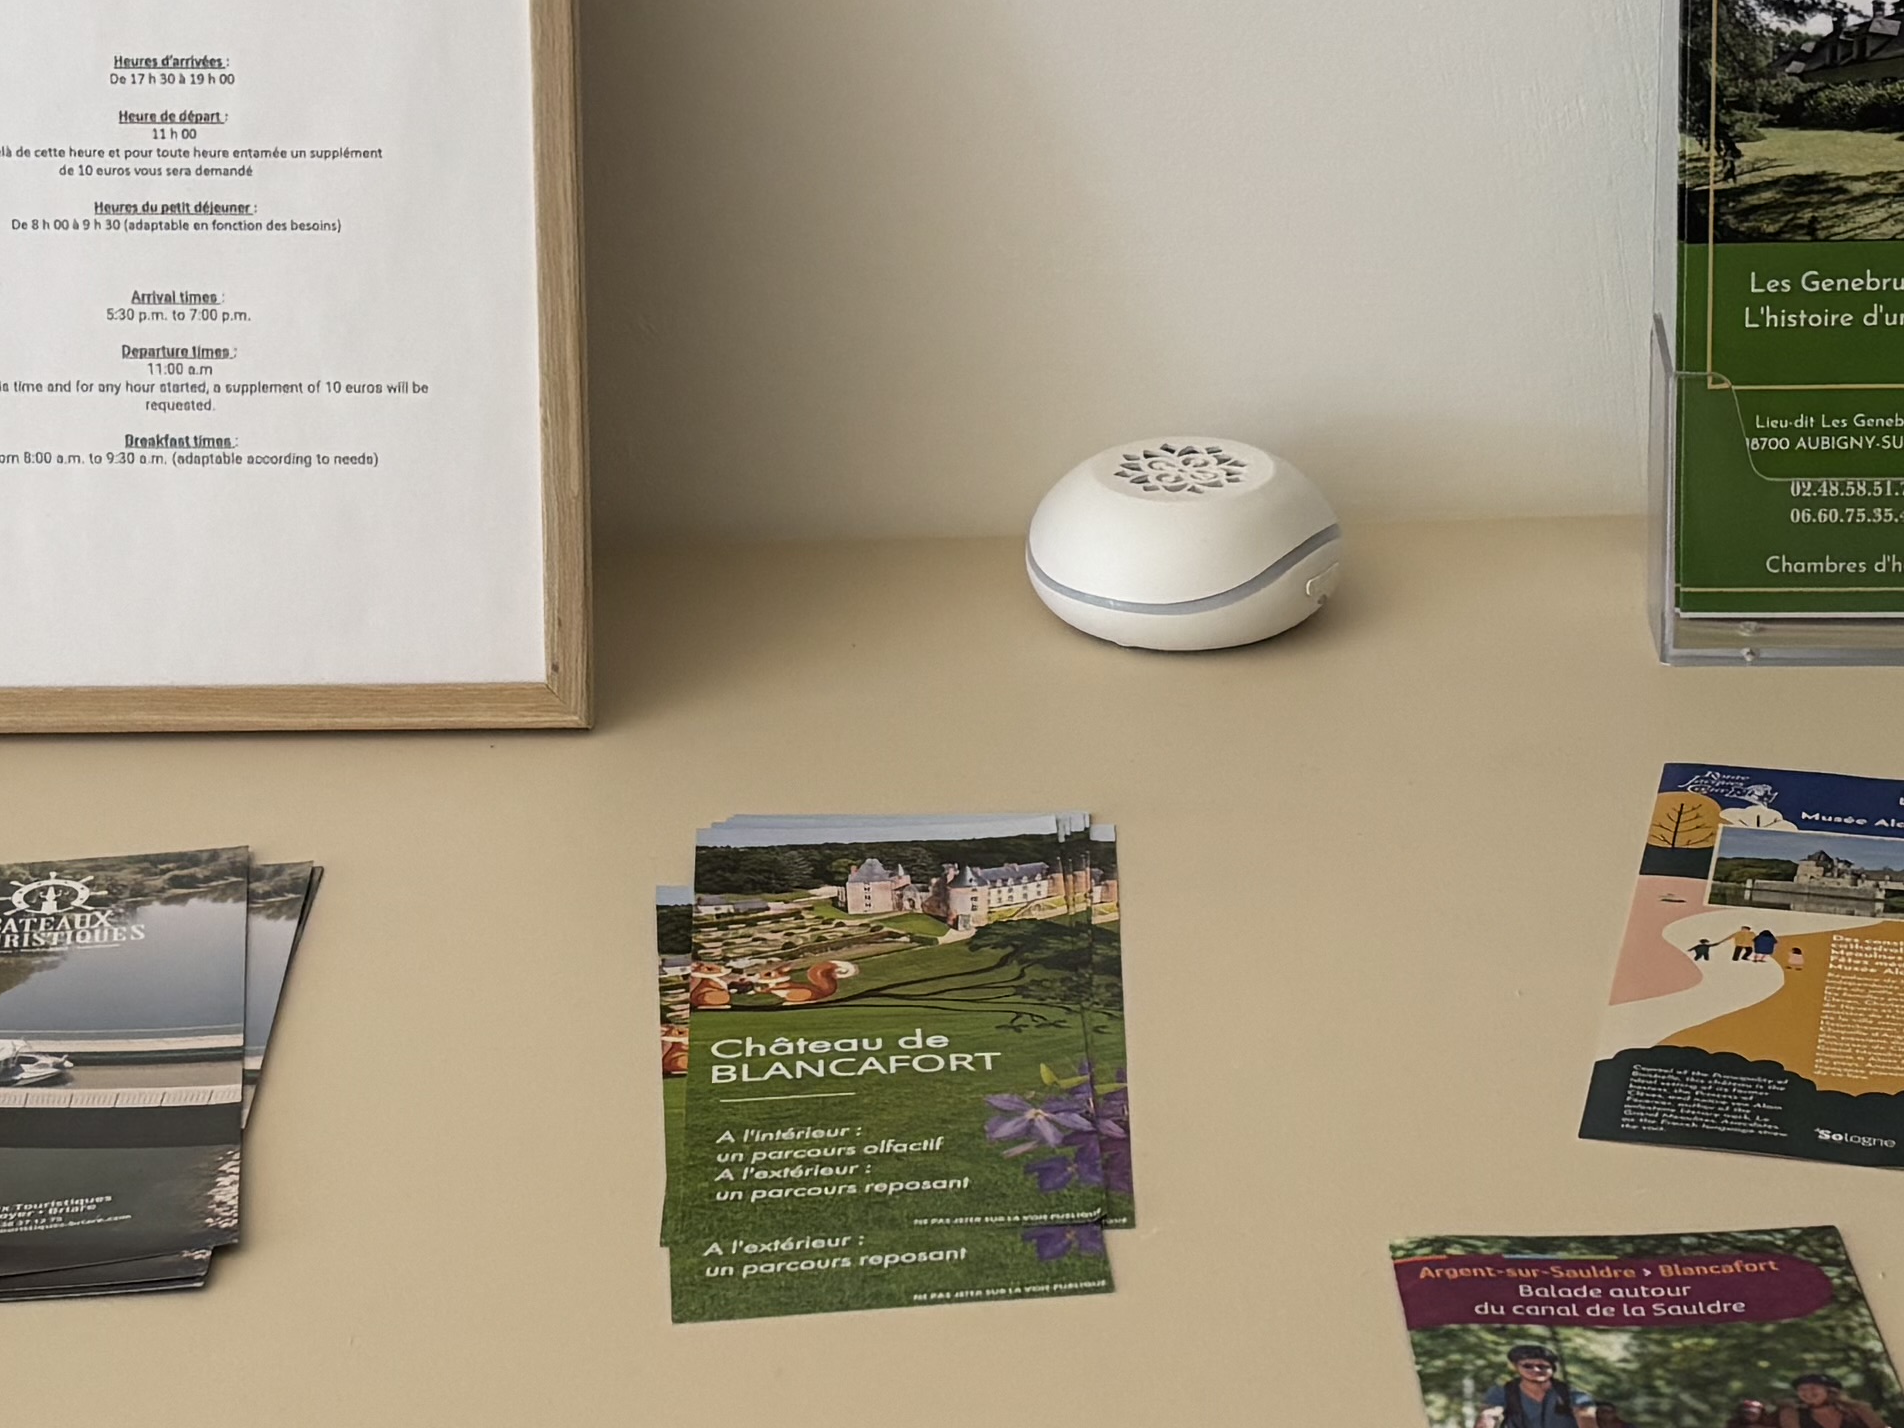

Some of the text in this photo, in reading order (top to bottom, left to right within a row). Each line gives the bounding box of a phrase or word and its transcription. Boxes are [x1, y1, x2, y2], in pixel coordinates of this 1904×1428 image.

[58, 164, 252, 176] de 10 euros vous sera demandé
[1750, 271, 1790, 292] Les
[1744, 304, 1853, 327] L'histoire
[1755, 413, 1814, 428] Lieu-dit
[1821, 413, 1847, 427] Les
[1765, 554, 1866, 573] Chambres
[1801, 811, 1868, 825] Musée
[710, 1027, 948, 1058] Château de
[711, 1051, 1001, 1082] BLANCAFORT
[715, 1130, 735, 1143] A
[743, 1126, 850, 1142] l'intérieur
[716, 1136, 944, 1164] un parcours olfactif
[1419, 1260, 1778, 1279] Argent-sur-Sauldre Blancafort
[1518, 1284, 1690, 1298] Balade autour
[1474, 1299, 1745, 1316] du canal de la Sauldre
